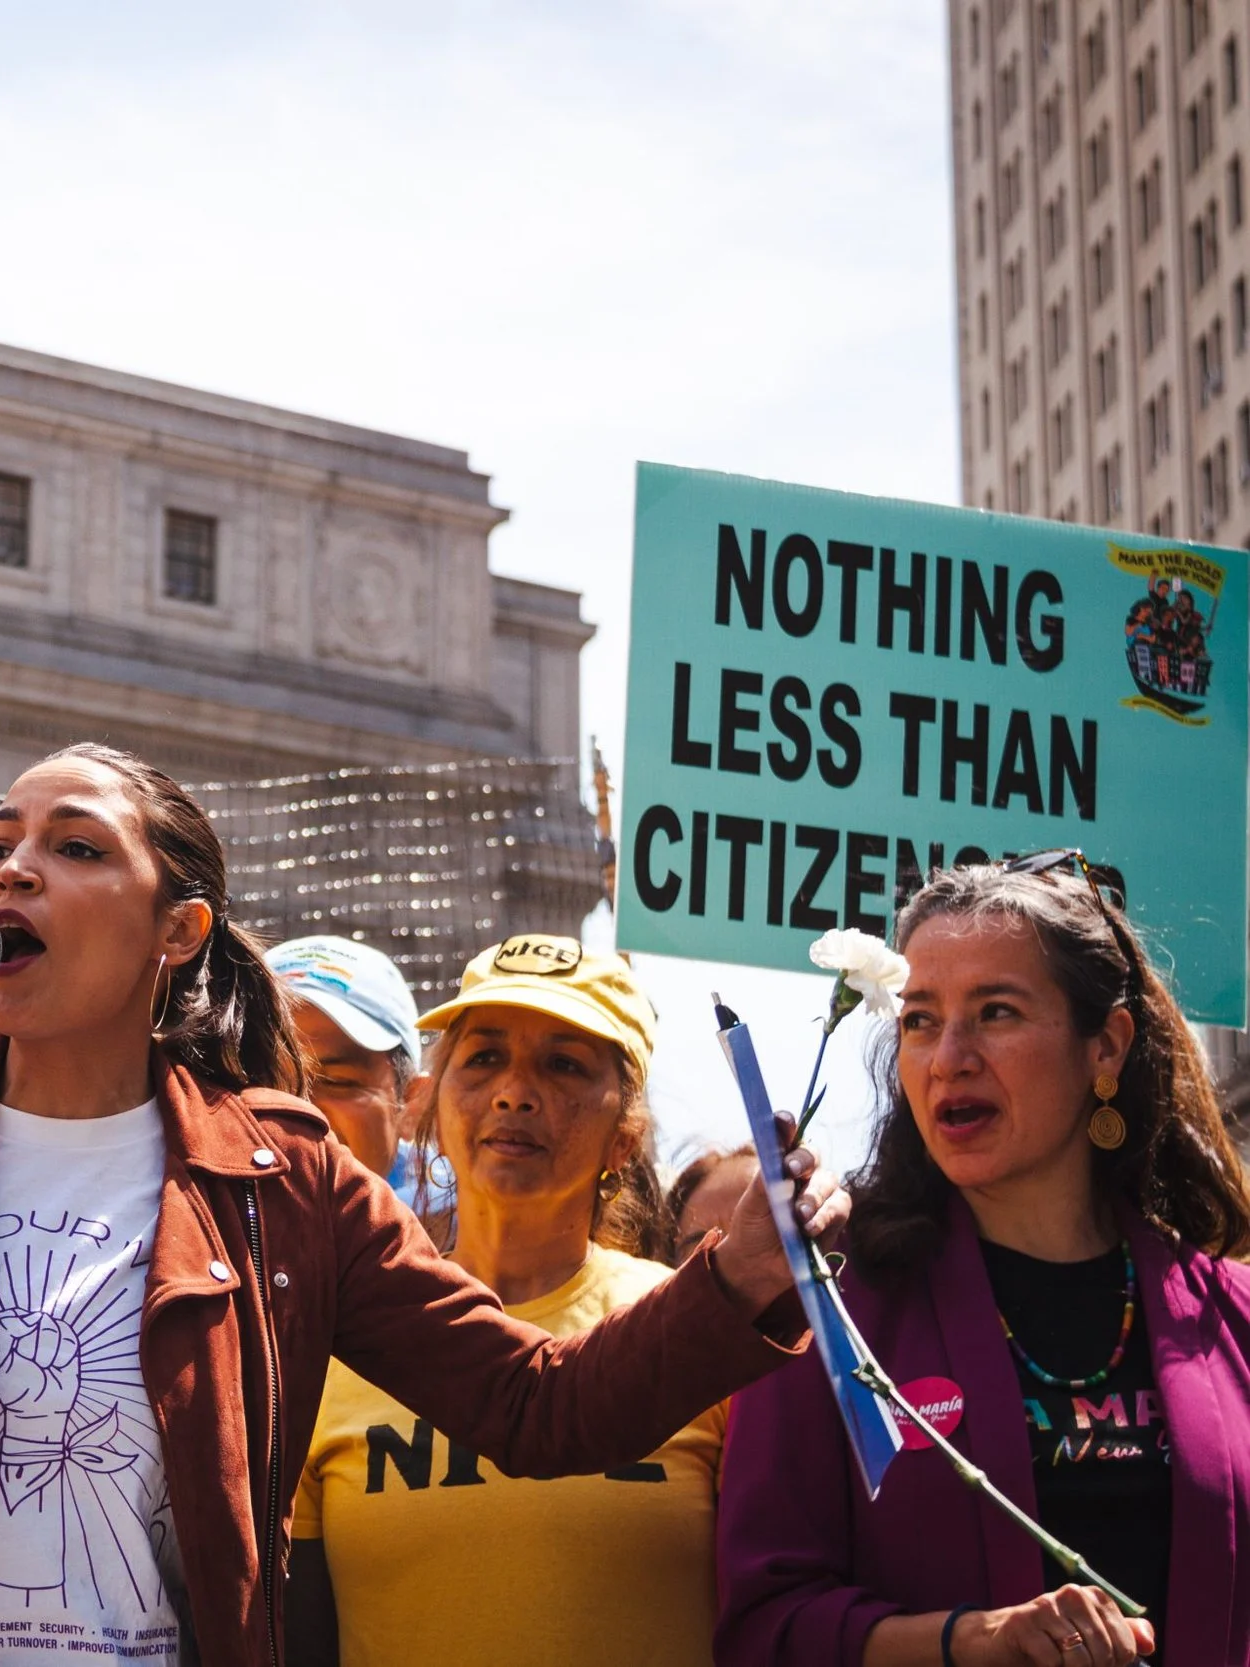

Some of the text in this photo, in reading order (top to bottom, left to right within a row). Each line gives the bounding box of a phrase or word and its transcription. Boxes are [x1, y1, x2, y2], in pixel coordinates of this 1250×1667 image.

[1118, 551, 1222, 580] MAKE THE ROAD
[1165, 566, 1190, 577] NEW
[715, 523, 1065, 673] NOTHING
[671, 661, 1098, 821] LESS THAN
[633, 804, 1127, 939] CITIZEN
[498, 941, 575, 964] NICE
[918, 1395, 963, 1416] MARÍA
[1052, 1431, 1143, 1467] New
[7, 1636, 57, 1650] TURNOVER
[68, 1640, 115, 1653] IMPROVED
[39, 1622, 85, 1635] SECURITY
[102, 1627, 129, 1640] HEALTH
[135, 1626, 177, 1641] INSURANCE
